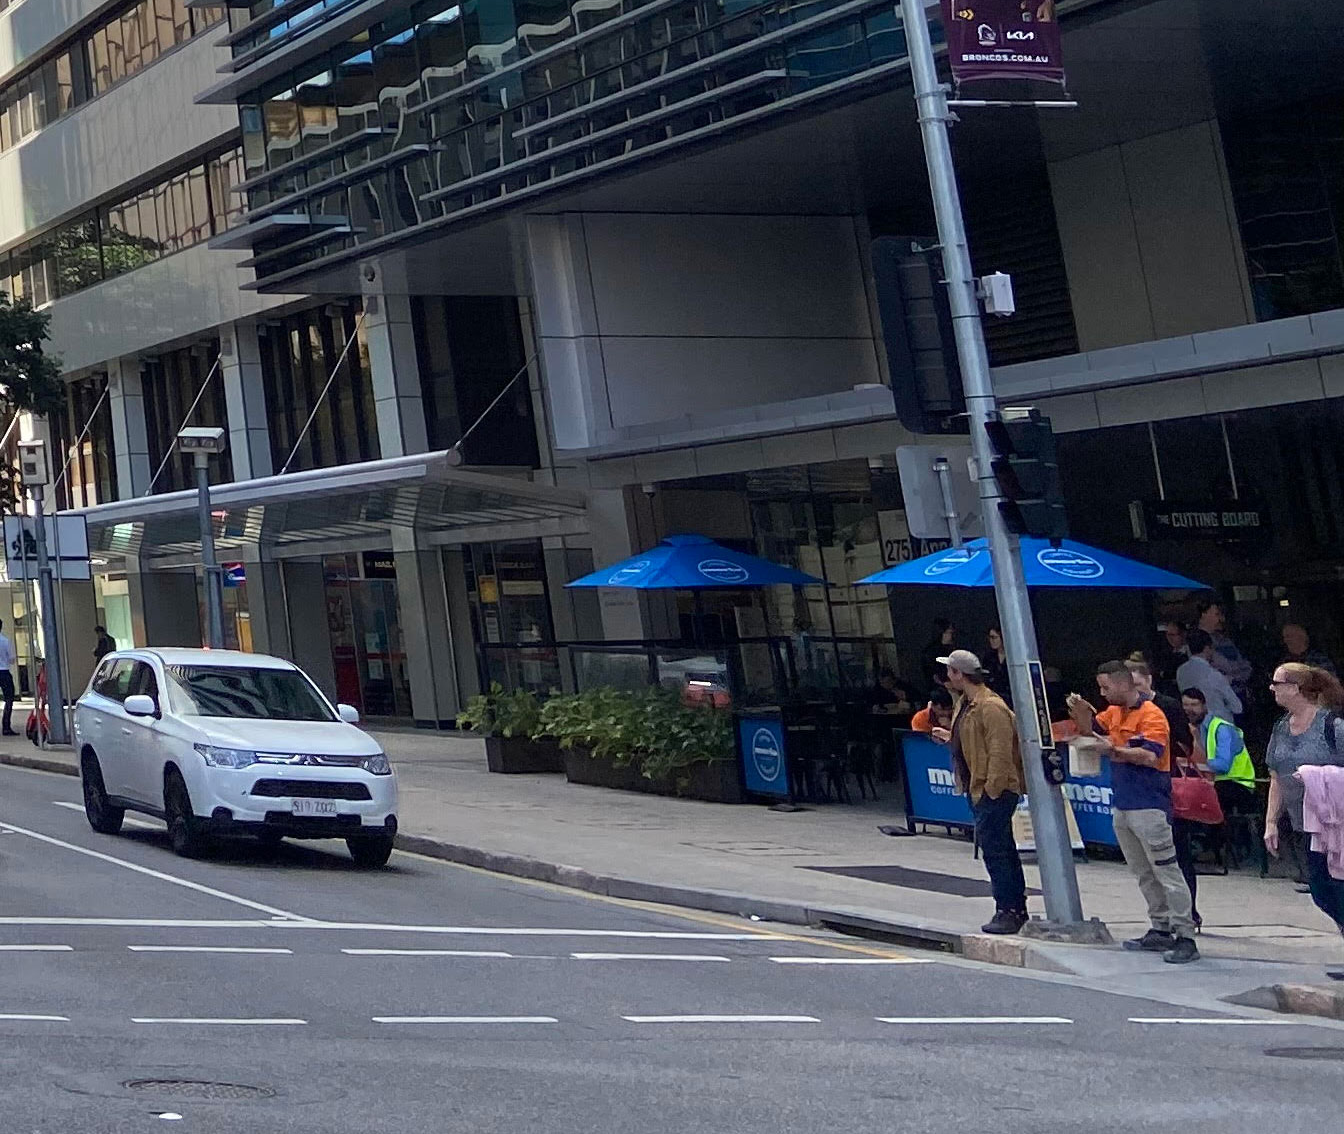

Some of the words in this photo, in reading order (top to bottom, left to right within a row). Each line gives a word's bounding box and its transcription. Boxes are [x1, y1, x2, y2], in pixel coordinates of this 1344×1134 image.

[1171, 512, 1220, 528] CUTTING
[1221, 511, 1260, 527] BOARD
[885, 539, 910, 562] 275
